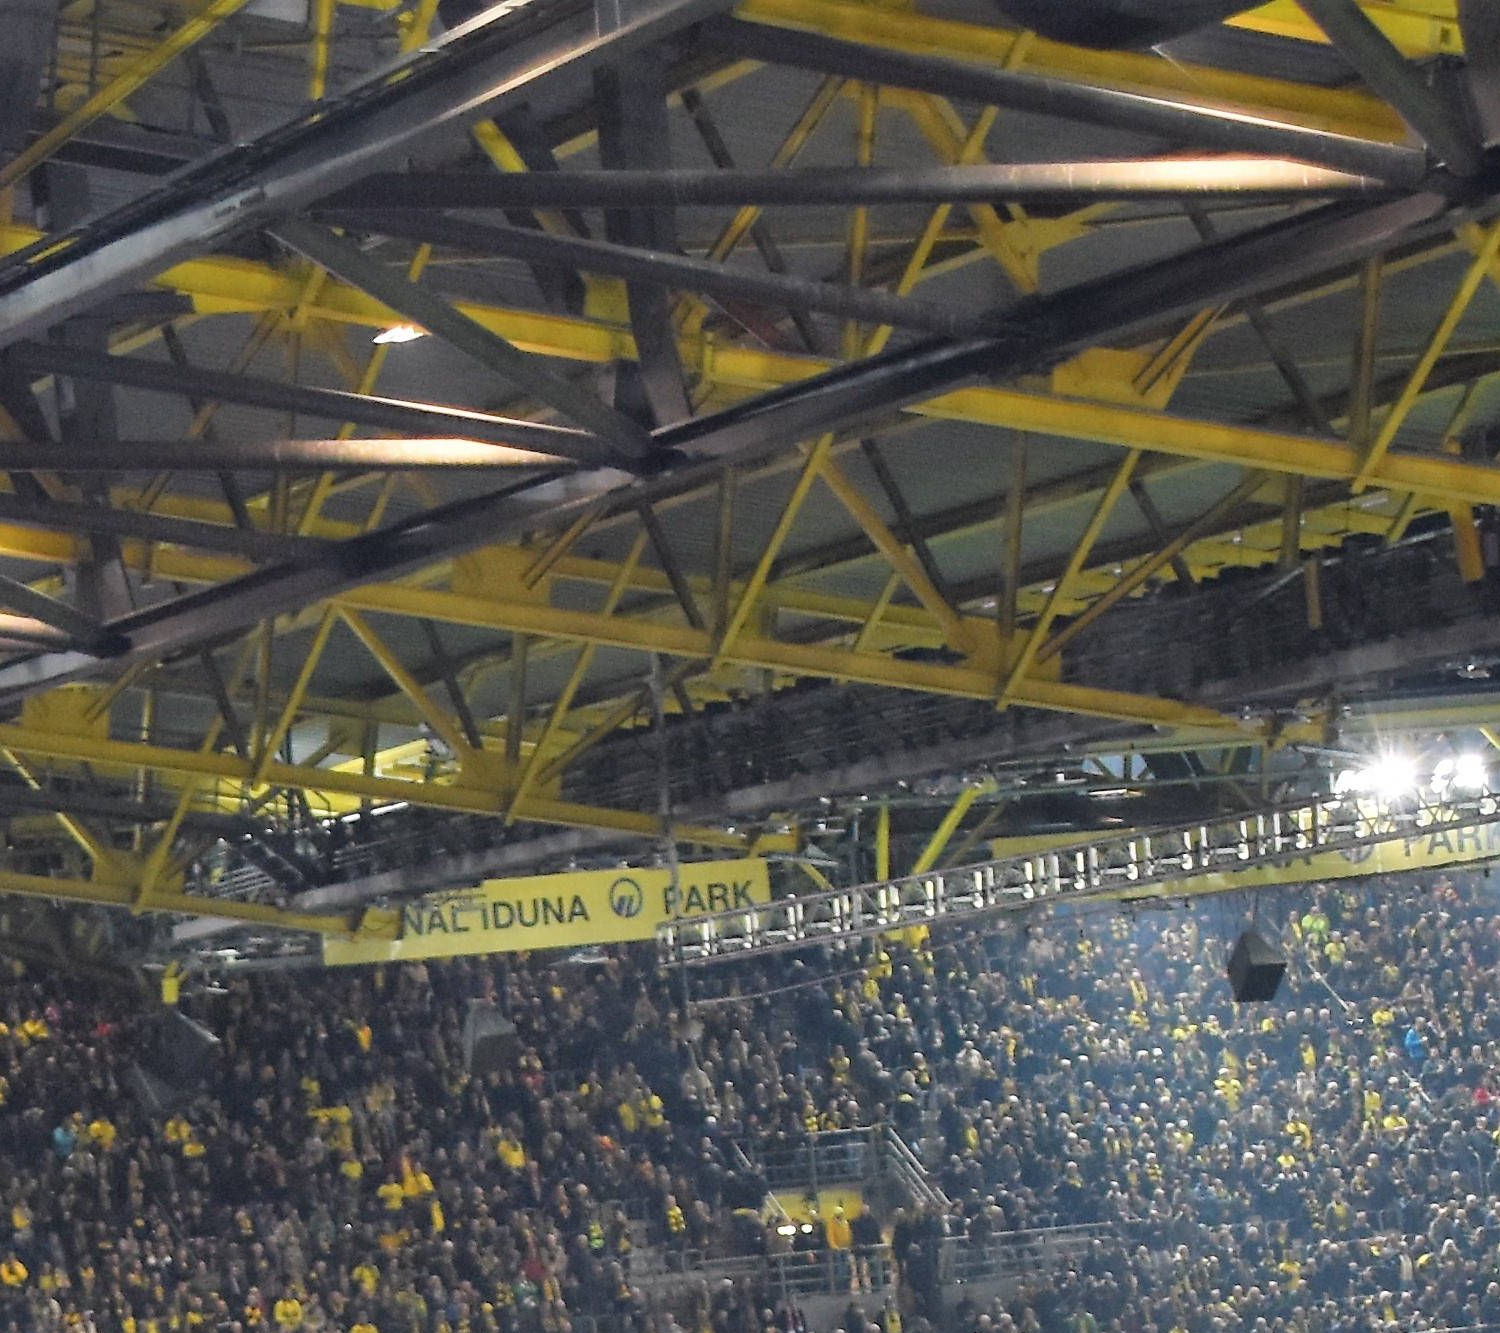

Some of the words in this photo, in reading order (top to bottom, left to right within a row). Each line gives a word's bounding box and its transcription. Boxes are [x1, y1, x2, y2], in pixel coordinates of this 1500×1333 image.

[403, 902, 474, 937] NAL
[481, 895, 591, 931] IDUNA
[664, 880, 752, 915] PARK
